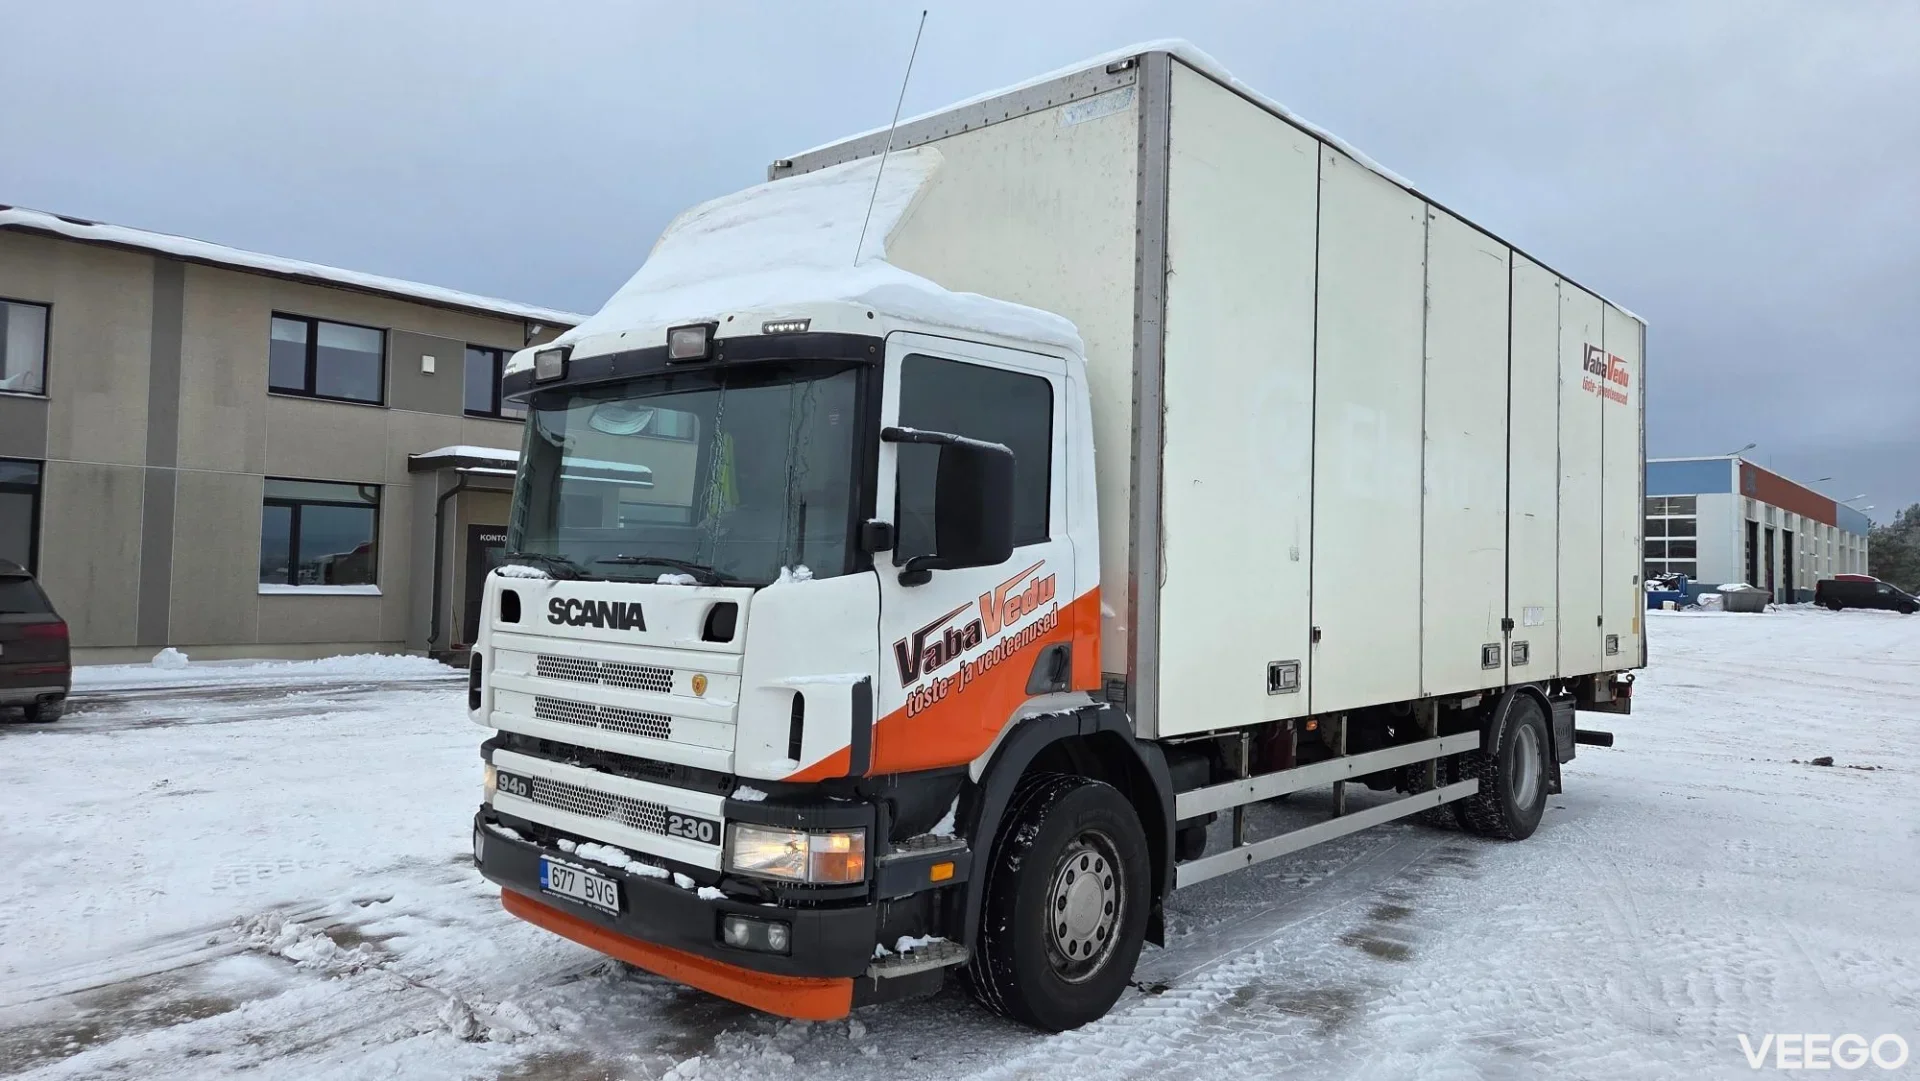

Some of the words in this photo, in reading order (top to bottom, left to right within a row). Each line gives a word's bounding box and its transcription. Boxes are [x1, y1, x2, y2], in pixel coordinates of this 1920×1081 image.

[546, 597, 647, 632] SCANIA
[906, 677, 954, 719] tõste-
[957, 660, 973, 693] ja
[977, 602, 1058, 676] veoteenused
[668, 815, 713, 842] 230
[552, 866, 575, 893] 677
[584, 876, 615, 906] BVG
